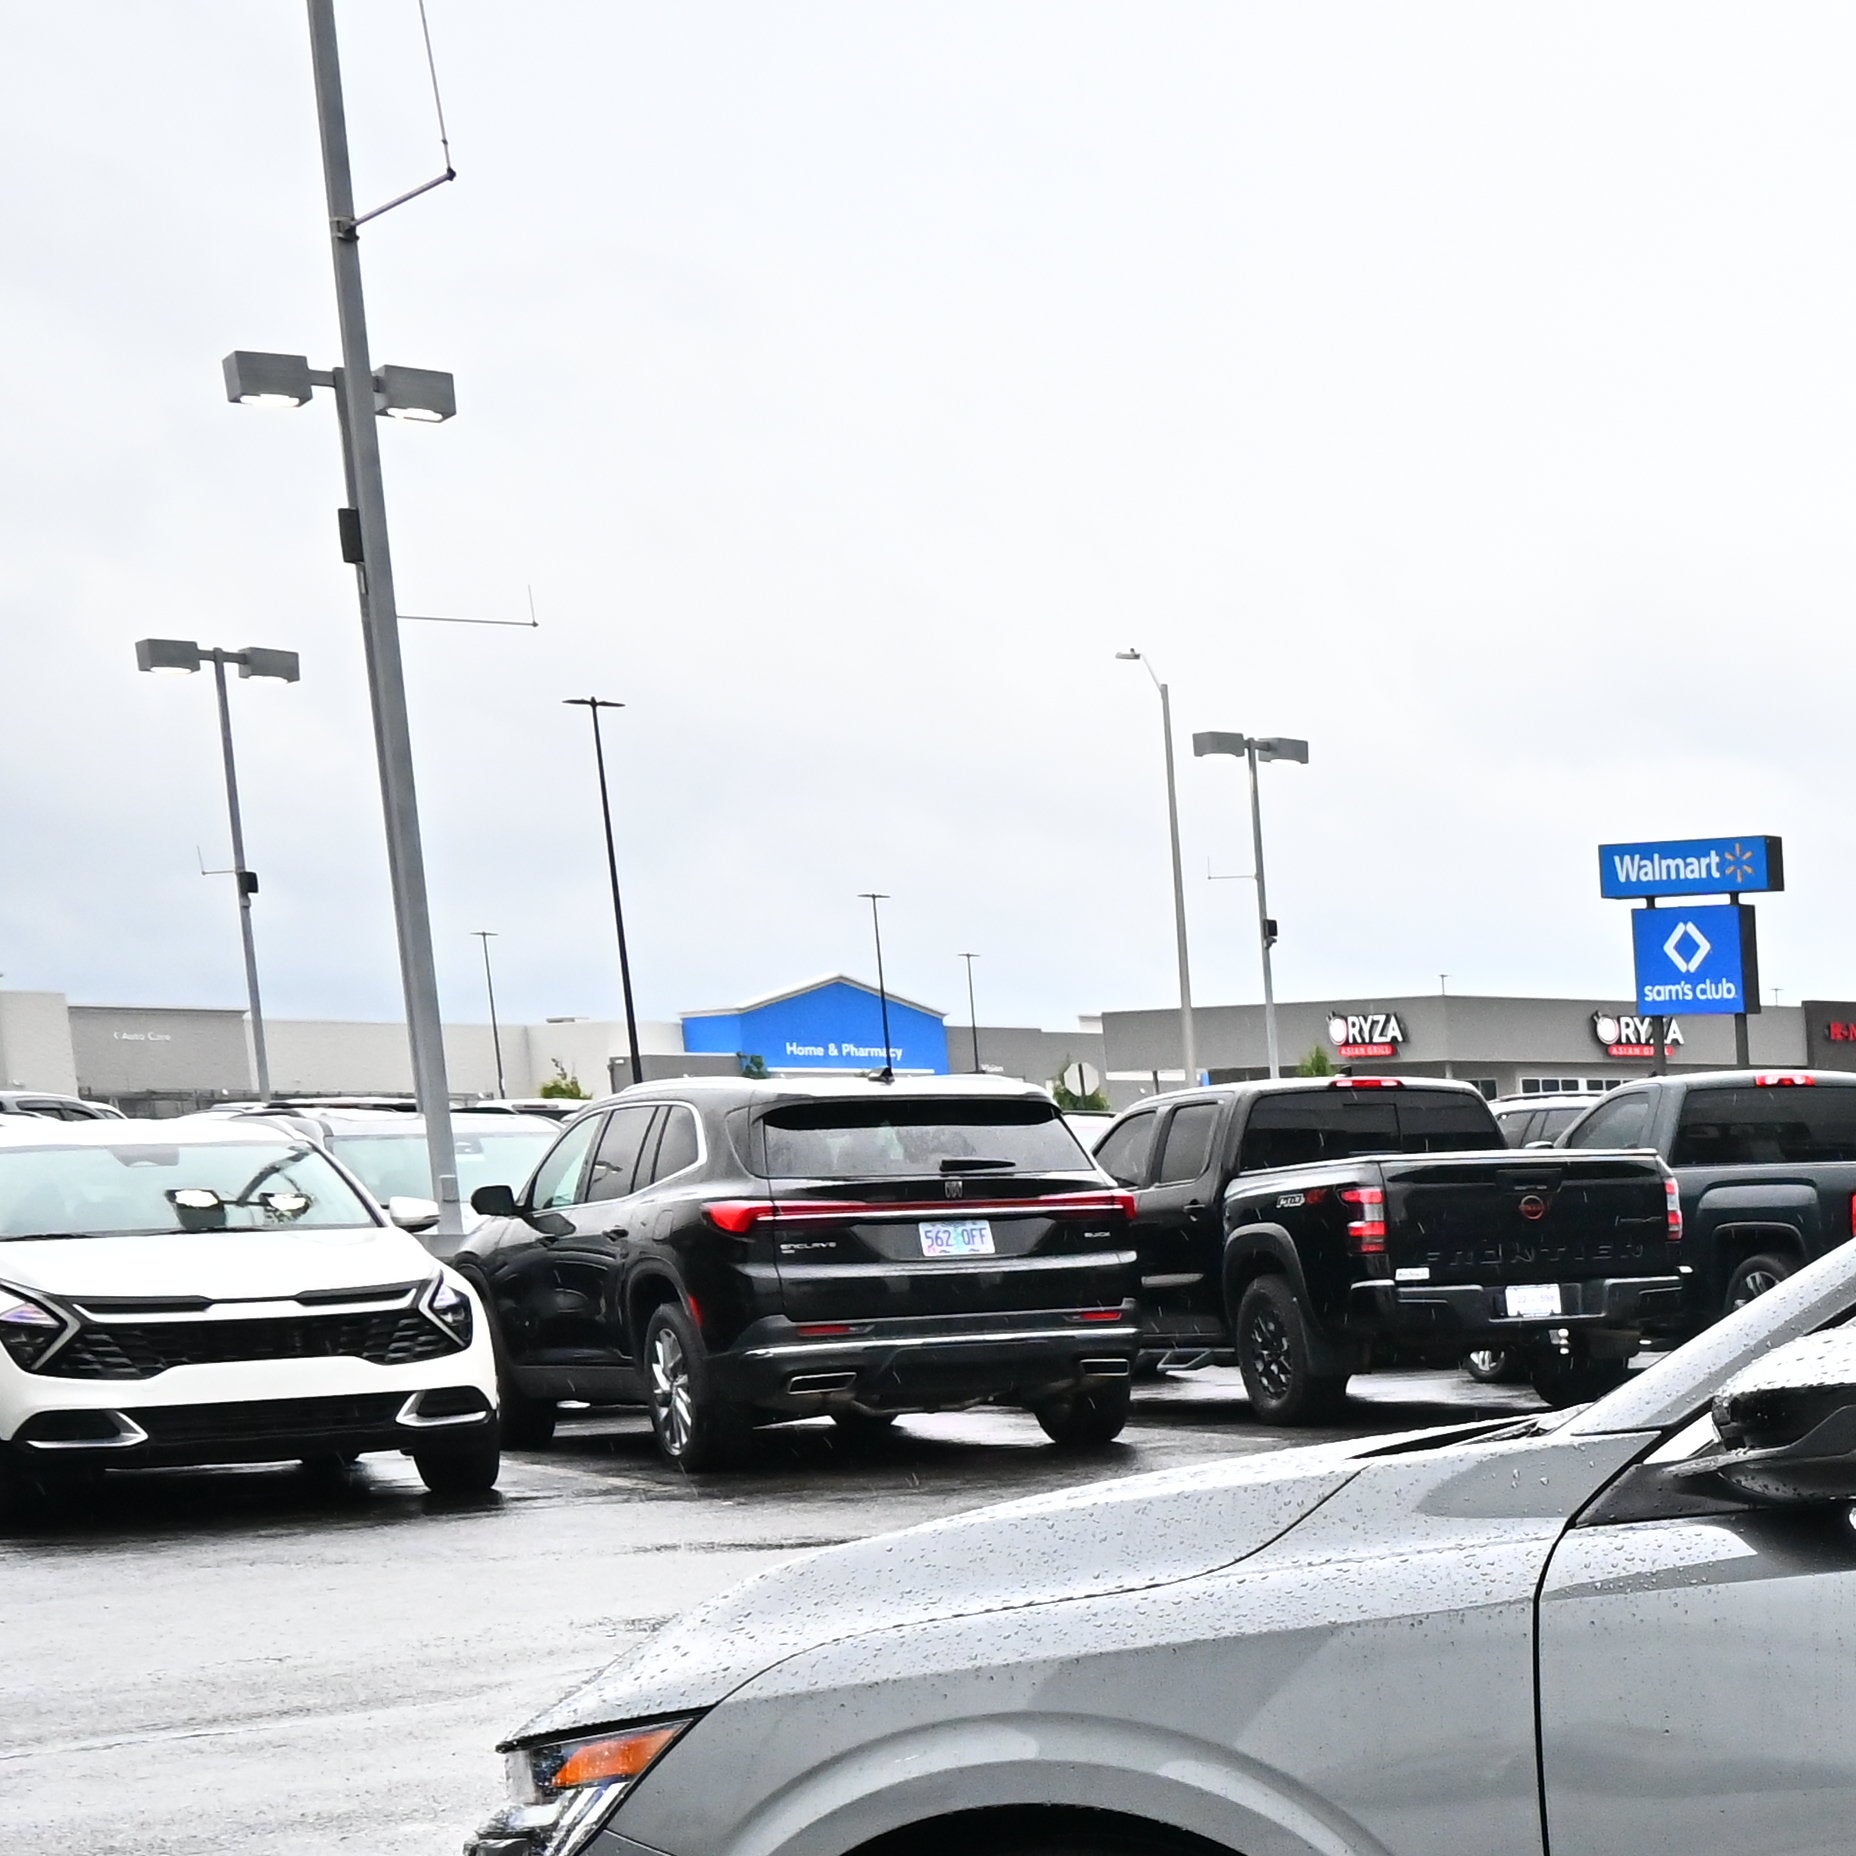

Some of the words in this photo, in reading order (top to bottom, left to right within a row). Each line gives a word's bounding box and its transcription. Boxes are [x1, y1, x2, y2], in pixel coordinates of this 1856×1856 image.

[1613, 850, 1720, 883] Walmart
[1644, 980, 1693, 1001] sam's
[1696, 977, 1736, 1000] club
[785, 1042, 824, 1056] Home
[828, 1043, 839, 1056] &
[841, 1043, 903, 1061] Pharmacy
[925, 1229, 953, 1248] 562
